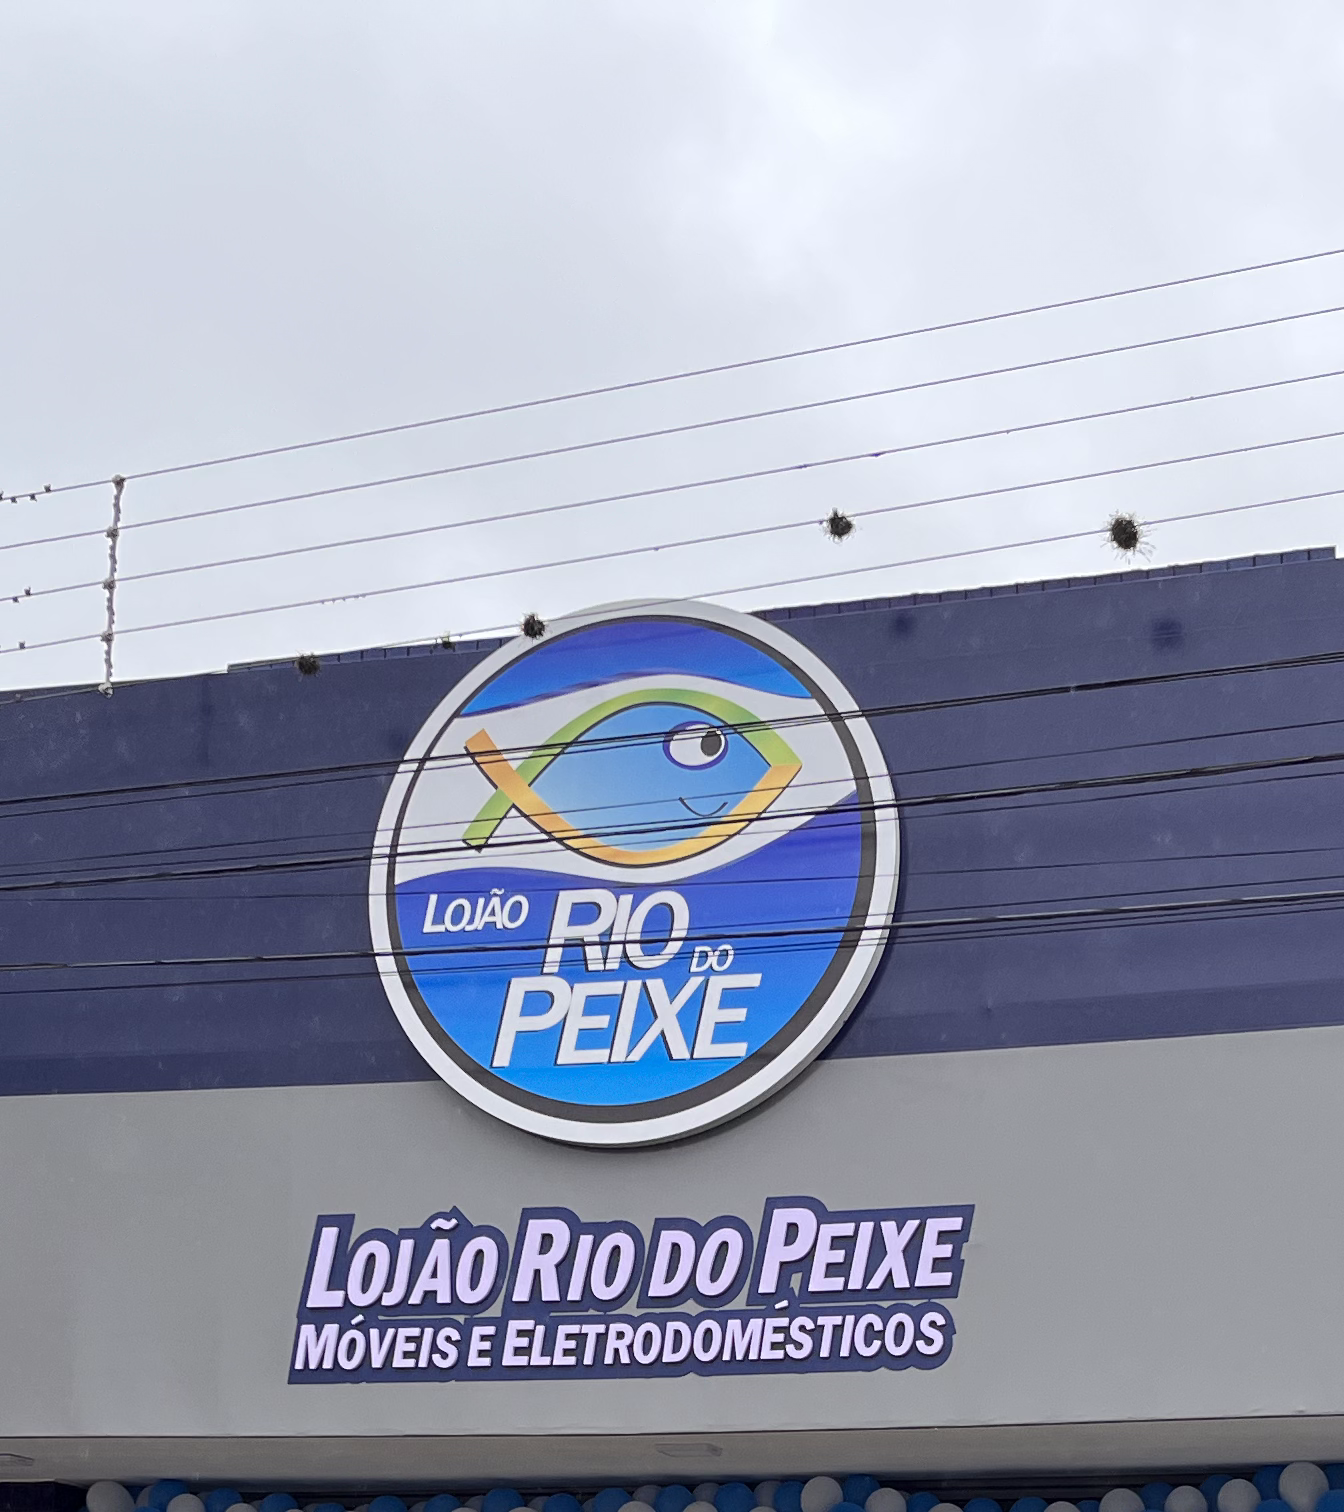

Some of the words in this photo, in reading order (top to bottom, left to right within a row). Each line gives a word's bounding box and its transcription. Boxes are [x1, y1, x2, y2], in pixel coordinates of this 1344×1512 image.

[422, 889, 528, 934] LOJÃO
[542, 889, 690, 974] RIO
[690, 944, 735, 973] DO
[492, 973, 761, 1068] PEIXE
[306, 1217, 497, 1309] LOJÃO
[512, 1217, 637, 1304] RIO
[647, 1228, 744, 1297] DO
[758, 1206, 963, 1295] PEIXE
[294, 1316, 460, 1370] MÓVEIS
[467, 1325, 495, 1367] E
[501, 1302, 946, 1366] ELETRODOMÉSTICOS
